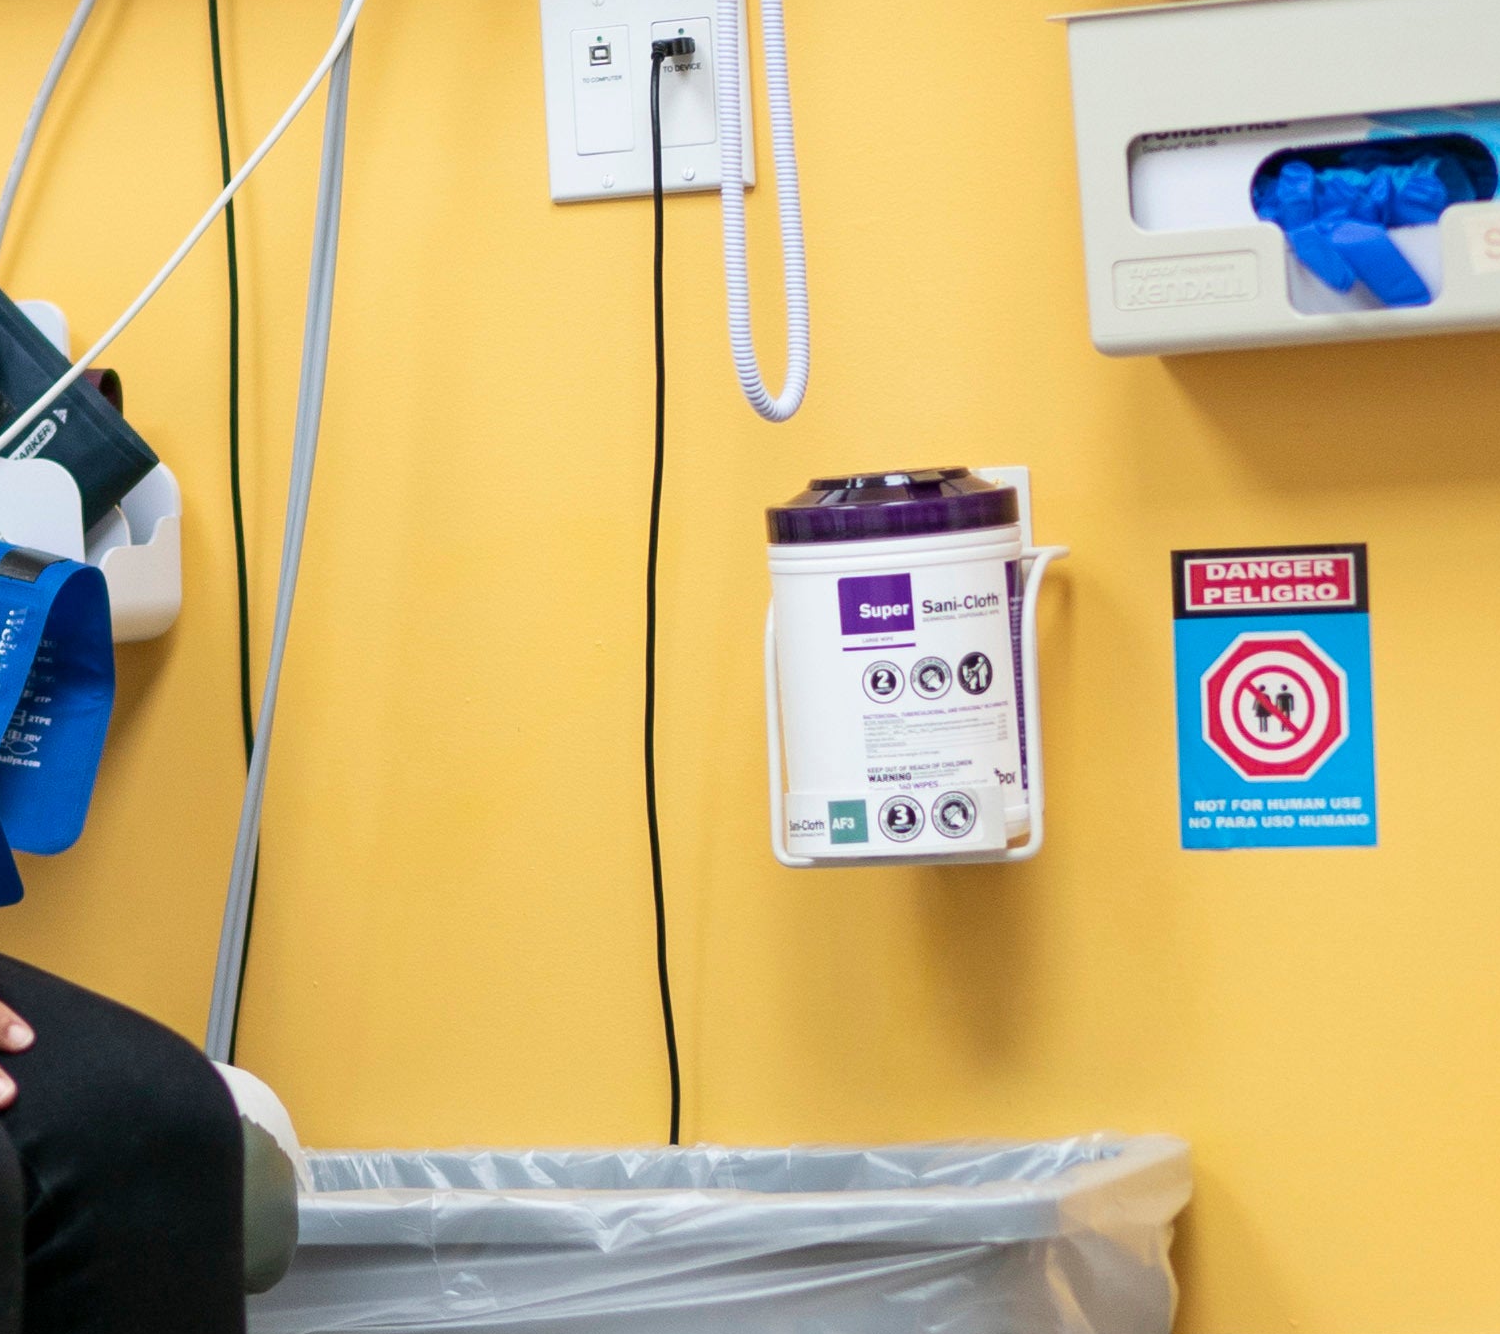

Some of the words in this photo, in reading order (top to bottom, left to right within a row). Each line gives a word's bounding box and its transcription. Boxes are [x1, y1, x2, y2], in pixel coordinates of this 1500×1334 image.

[663, 65, 673, 73] TO
[675, 62, 700, 72] DEVICE
[13, 424, 52, 460] ARKER
[1205, 560, 1335, 581] DANGER
[1203, 583, 1339, 604] PELIGRO
[859, 603, 911, 621] Super
[921, 592, 1000, 614] Sani-Cloth
[876, 671, 890, 690] 2
[909, 763, 930, 771] REACH
[941, 759, 973, 768] CHILDREN
[867, 772, 912, 783] WARNING
[913, 780, 939, 790] WIPES
[1194, 799, 1227, 813] NOT
[1231, 798, 1263, 812] FOR
[1267, 796, 1327, 811] HUMAN
[1330, 795, 1363, 809] USE
[832, 818, 855, 830] AF3
[894, 804, 909, 826] 3
[1188, 816, 1212, 830] NO
[1215, 815, 1257, 829] PARA
[1261, 814, 1295, 828] USO
[1298, 812, 1371, 828] HUMANO
